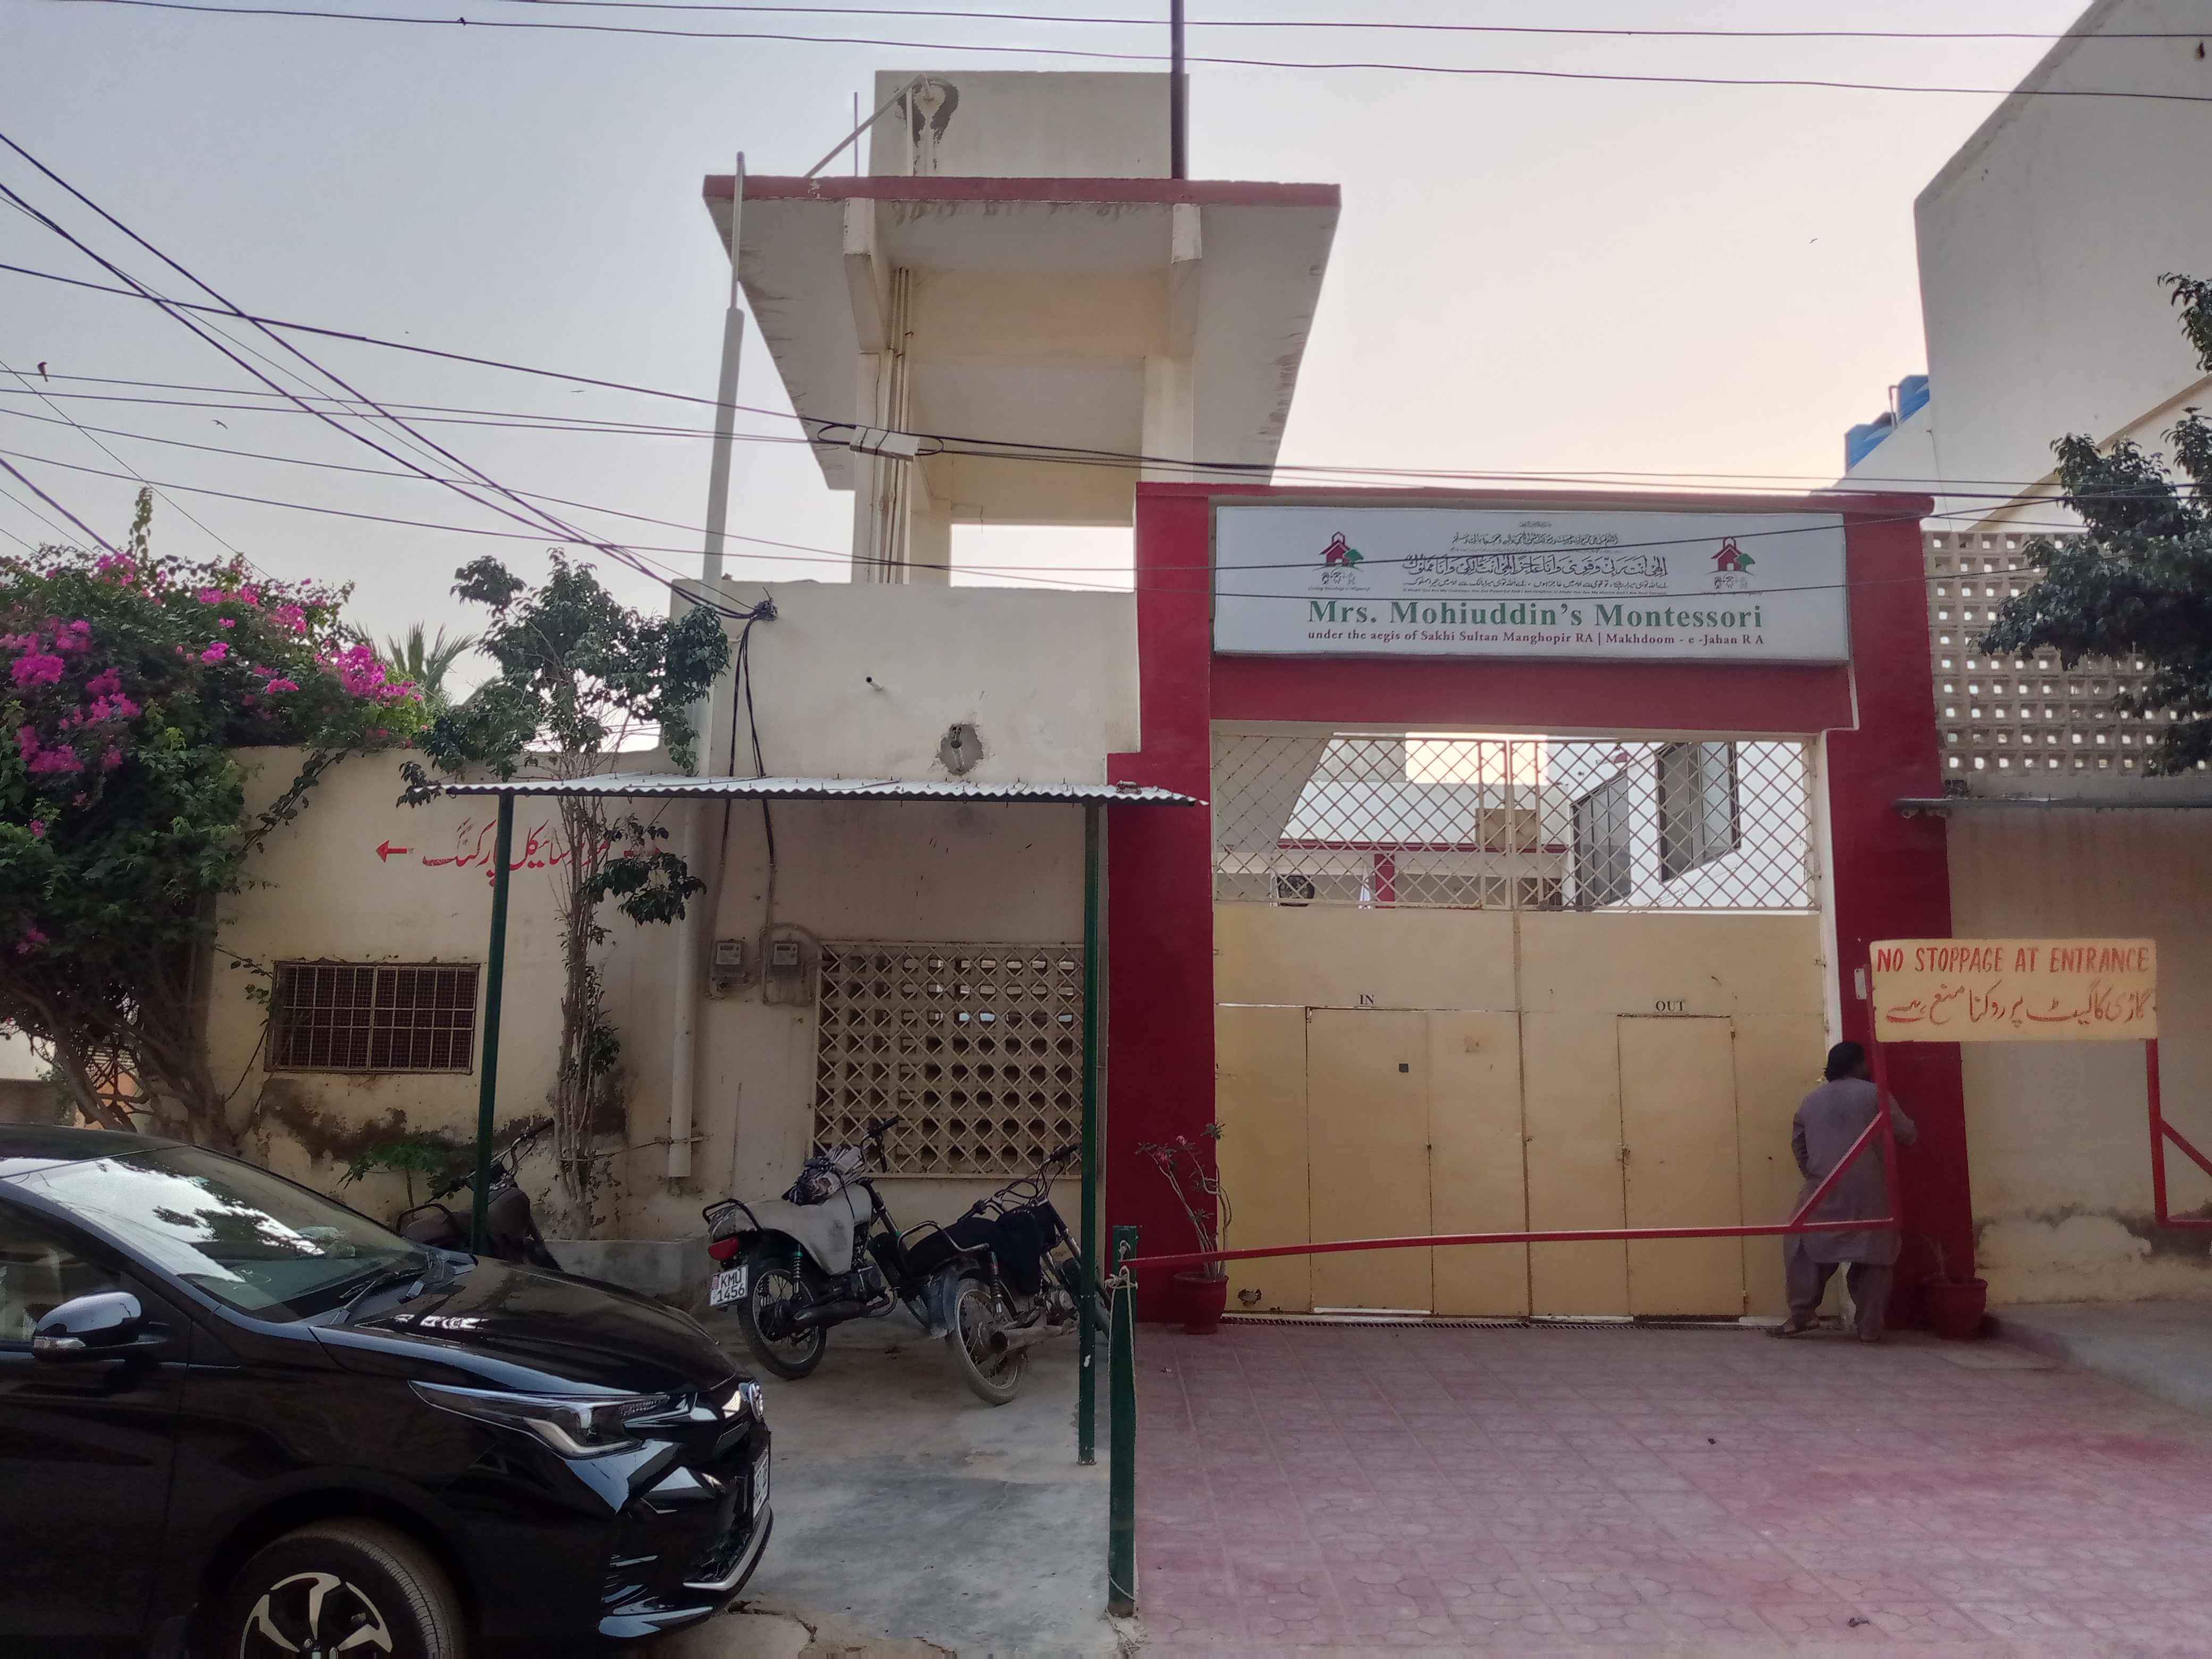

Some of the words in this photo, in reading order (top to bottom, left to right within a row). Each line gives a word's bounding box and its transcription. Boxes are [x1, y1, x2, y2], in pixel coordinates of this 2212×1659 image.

[1308, 600, 1377, 623] Mrs.
[1594, 604, 1763, 627] Montessori
[1308, 629, 1343, 639] under
[1348, 630, 1367, 639] the
[1371, 631, 1400, 643] aegis
[1404, 630, 1419, 640] of
[1420, 630, 1455, 641] Sakhi
[1460, 631, 1498, 641] Sultan
[1503, 632, 1571, 645] Manghopir
[1576, 632, 1594, 642] RA
[1605, 633, 1674, 644] Makhdoom
[1877, 948, 1904, 973] NO
[1915, 946, 2004, 973] STOPPAGE
[2015, 947, 2038, 973] AT
[2050, 946, 2150, 973] ENTRANCE
[1359, 994, 1374, 1005] IN
[1656, 1000, 1686, 1011] OUT
[721, 1267, 742, 1288] KMU
[716, 1283, 745, 1302] 1456
